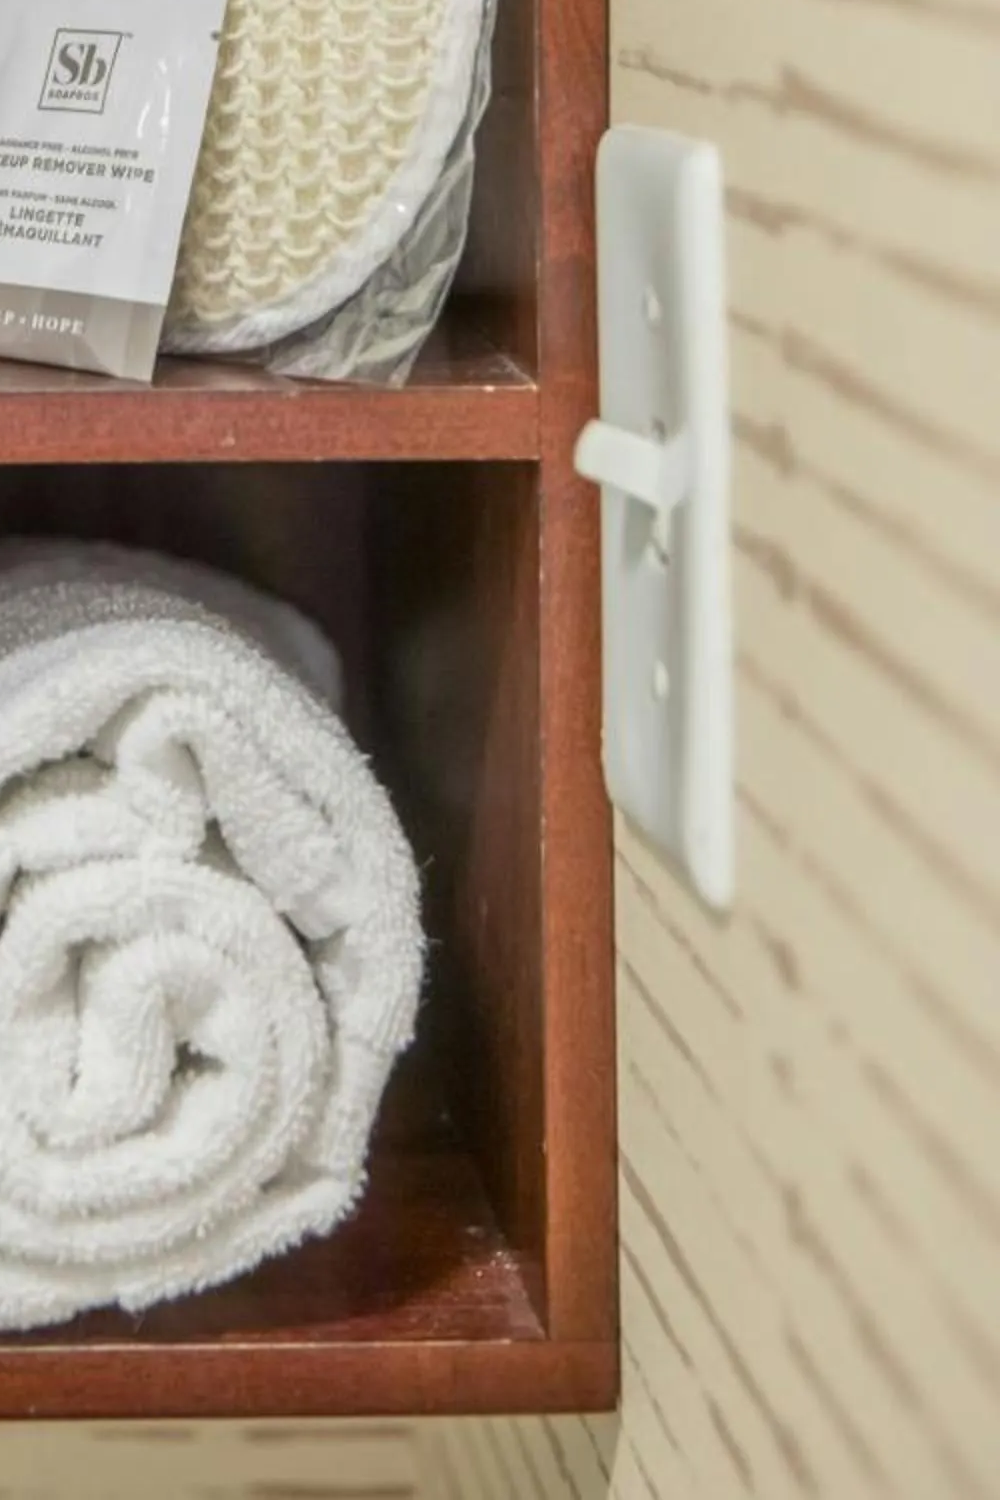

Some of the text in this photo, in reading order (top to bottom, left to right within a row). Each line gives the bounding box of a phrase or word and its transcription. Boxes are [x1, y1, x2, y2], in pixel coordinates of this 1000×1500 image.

[52, 42, 107, 86] Sb
[32, 157, 107, 177] REMOVER
[111, 164, 156, 184] WIPE
[9, 205, 86, 228] LINGETTE
[31, 313, 84, 335] HOPE
